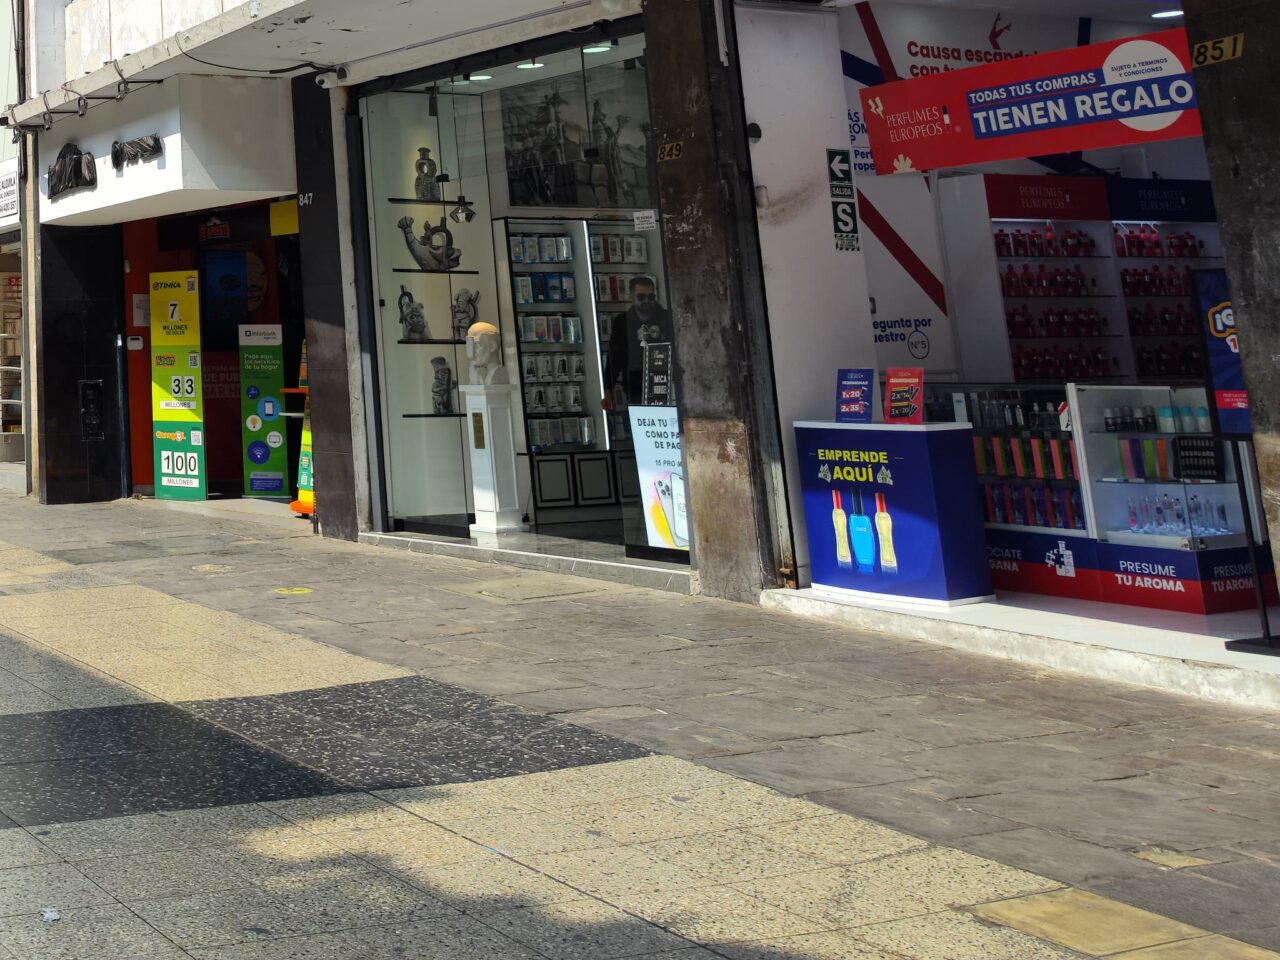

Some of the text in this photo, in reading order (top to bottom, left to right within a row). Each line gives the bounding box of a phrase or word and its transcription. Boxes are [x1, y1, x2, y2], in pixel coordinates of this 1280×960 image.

[907, 41, 961, 61] Causa
[1194, 36, 1238, 66] 851
[1124, 66, 1163, 77] CONDICIONES
[969, 72, 1096, 104] TODAS TUS COMPRAS
[973, 79, 1193, 134] TIENEN REGALO
[886, 106, 940, 127] PERFUMES
[889, 122, 943, 143] EUROPEOS
[659, 143, 682, 160] 849
[299, 193, 313, 206] 847
[837, 203, 854, 232] S
[162, 323, 188, 331] MILLONES
[872, 318, 932, 332] egunta por
[164, 401, 191, 409] MILLONES
[637, 418, 656, 427] DEJA
[658, 419, 668, 428] TU
[645, 431, 669, 439] COMO
[654, 441, 681, 450] DE PAG
[163, 454, 197, 472] 100
[663, 459, 676, 467] PRO
[817, 448, 889, 464] EMPRENDE
[832, 464, 874, 482] AQUÍ
[166, 477, 194, 486] MILLONES
[1120, 560, 1176, 577] PRESUME
[1115, 573, 1185, 592] TU AROMA
[1212, 578, 1256, 593] TU AROM
